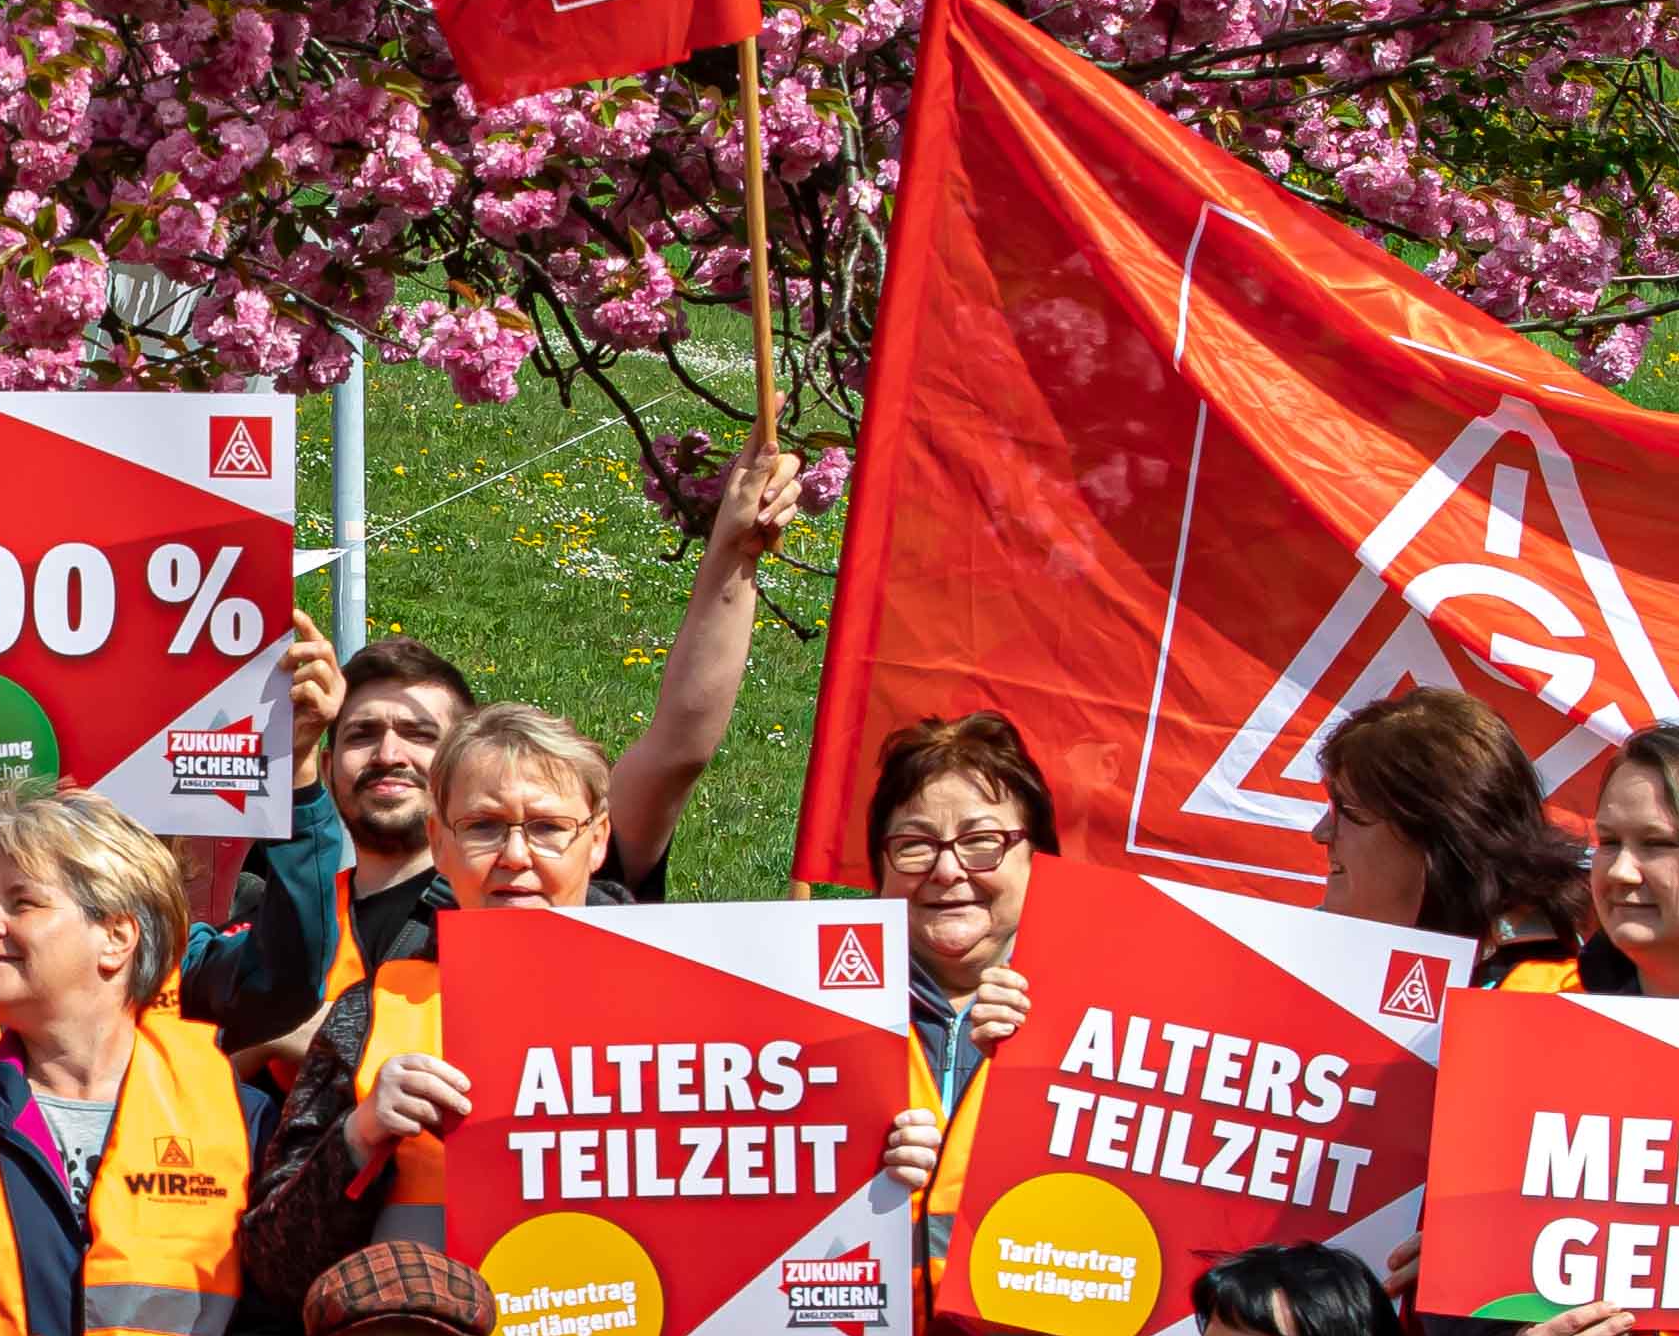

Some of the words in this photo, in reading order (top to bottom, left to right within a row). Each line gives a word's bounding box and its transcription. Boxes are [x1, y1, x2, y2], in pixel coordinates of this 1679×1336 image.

[147, 543, 264, 656] %
[170, 732, 259, 753] ZUKUNFT
[175, 755, 266, 776] SICHERN.
[513, 1040, 838, 1117] ALTERS-
[1059, 1006, 1377, 1127] ALTERS-
[508, 1124, 848, 1200] TEILZEIT
[1045, 1084, 1374, 1215] TEILZEIT
[123, 1172, 187, 1195] WIR
[188, 1173, 217, 1185] FÜR
[189, 1188, 228, 1198] MEHR
[785, 1262, 877, 1282] ZUKUNFT
[998, 1238, 1137, 1279] Tarifvertrag
[495, 1281, 636, 1315] Tarifvertrag
[790, 1286, 885, 1306] SICHERN.
[997, 1270, 1132, 1302] verlängern!
